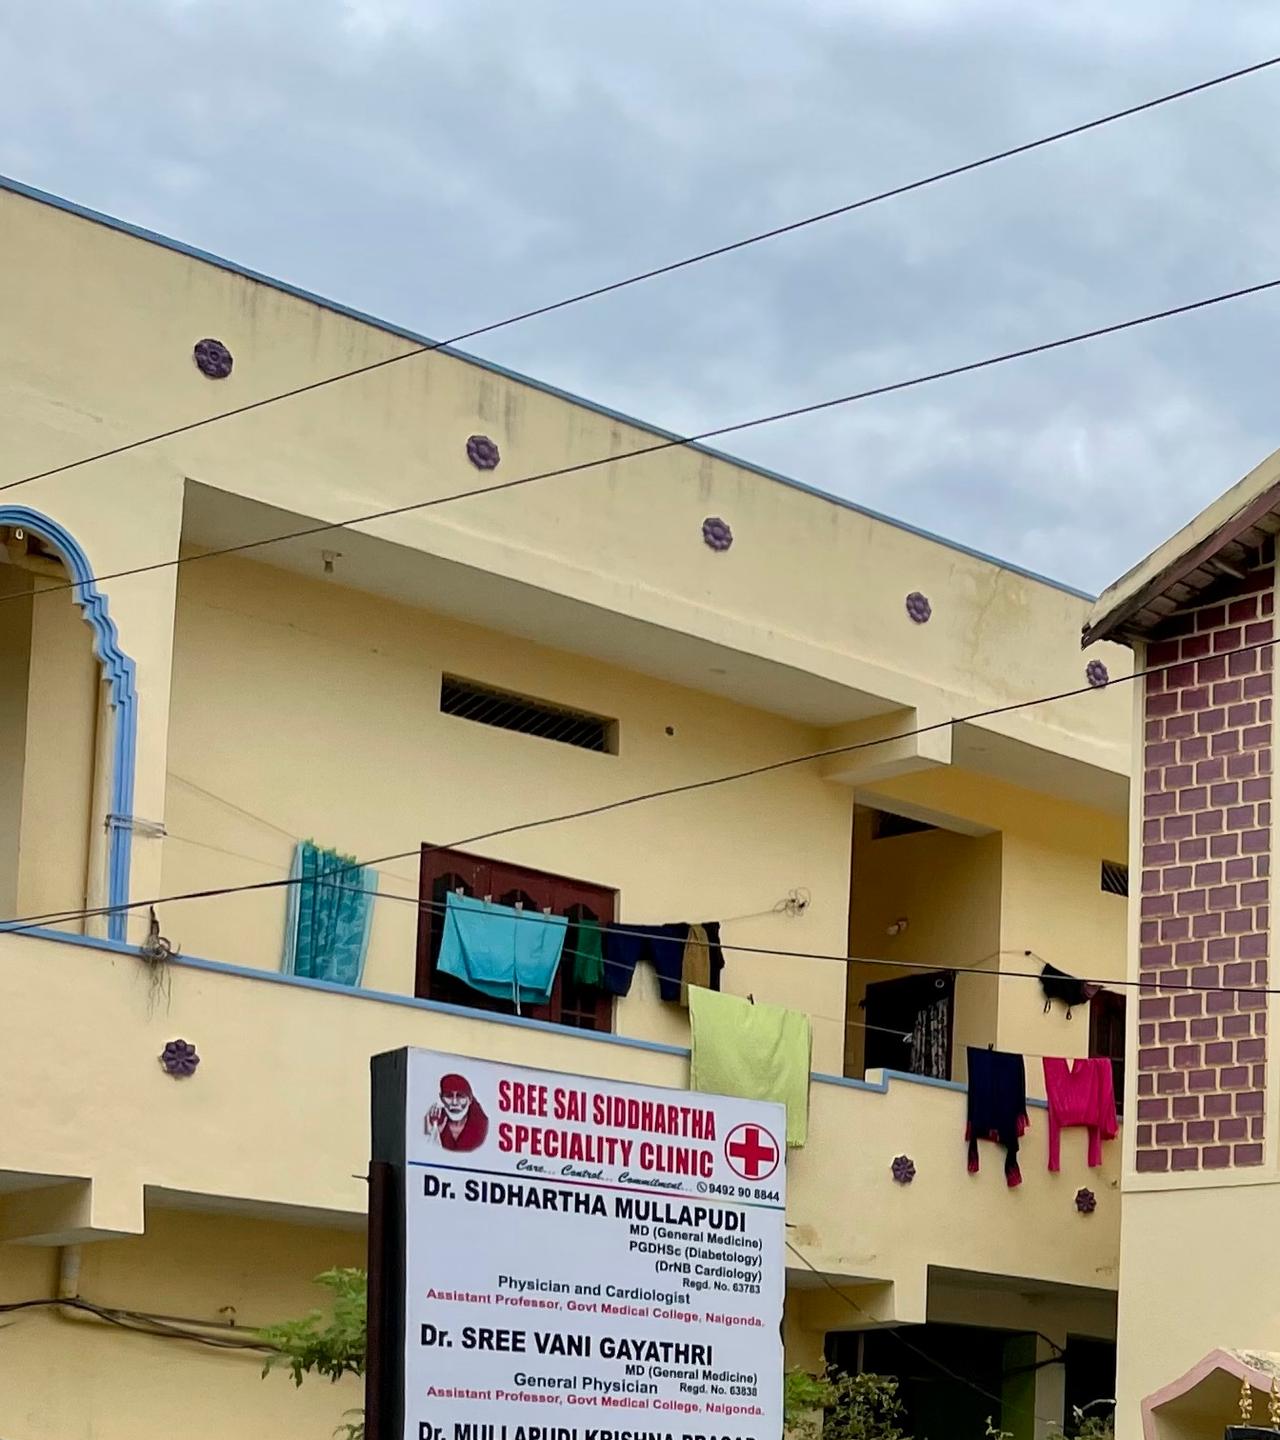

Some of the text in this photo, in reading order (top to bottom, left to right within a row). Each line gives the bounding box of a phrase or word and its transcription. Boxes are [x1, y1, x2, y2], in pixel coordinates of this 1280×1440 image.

[499, 1080, 716, 1141] SREE SAI SIDDHARTHA
[499, 1123, 713, 1178] SPECIALITY CLINIC
[424, 1174, 745, 1232] Dr. SIDHARTHA MULLAPUDI
[709, 1183, 779, 1202] 9492 90 8844
[630, 1224, 762, 1251] MD (General Medicine)
[630, 1240, 762, 1267] PGDHSc (Diabetology)
[655, 1260, 762, 1283] (DrNB Cardiology)
[683, 1278, 711, 1291] Regd.
[714, 1281, 730, 1291] No.
[499, 1275, 690, 1305] Physician and Cardiologist
[427, 1288, 764, 1327] Assistant Professor, Govt Medical College, Nalgonda.
[421, 1324, 712, 1366] Dr. SREE VANI GAYATHRI
[514, 1373, 658, 1394] General Physician
[625, 1364, 757, 1385] MD (General Medicine)
[427, 1386, 764, 1415] Assistant Professor, Govt Medical College, Nalgonda.
[680, 1382, 708, 1395] Regd.
[711, 1384, 727, 1395] No.
